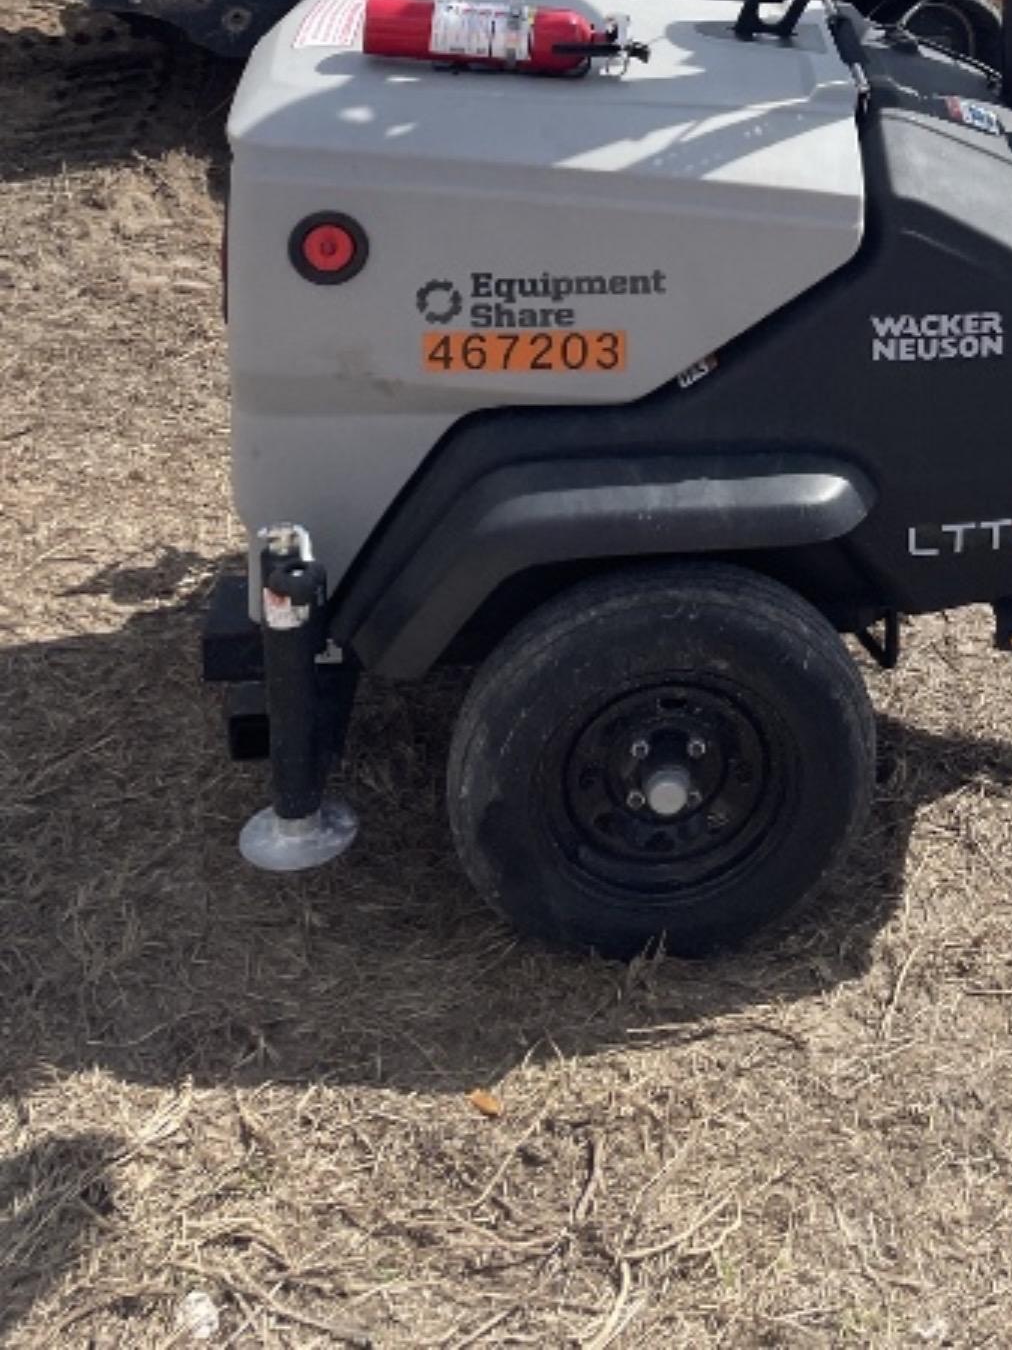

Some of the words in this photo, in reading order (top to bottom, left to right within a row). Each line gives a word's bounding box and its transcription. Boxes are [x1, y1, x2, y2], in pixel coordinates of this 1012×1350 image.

[470, 270, 666, 303] Equipment
[470, 303, 575, 328] Share
[870, 311, 1003, 337] WACKER
[427, 332, 619, 369] 467203
[872, 335, 1003, 361] NEUSON
